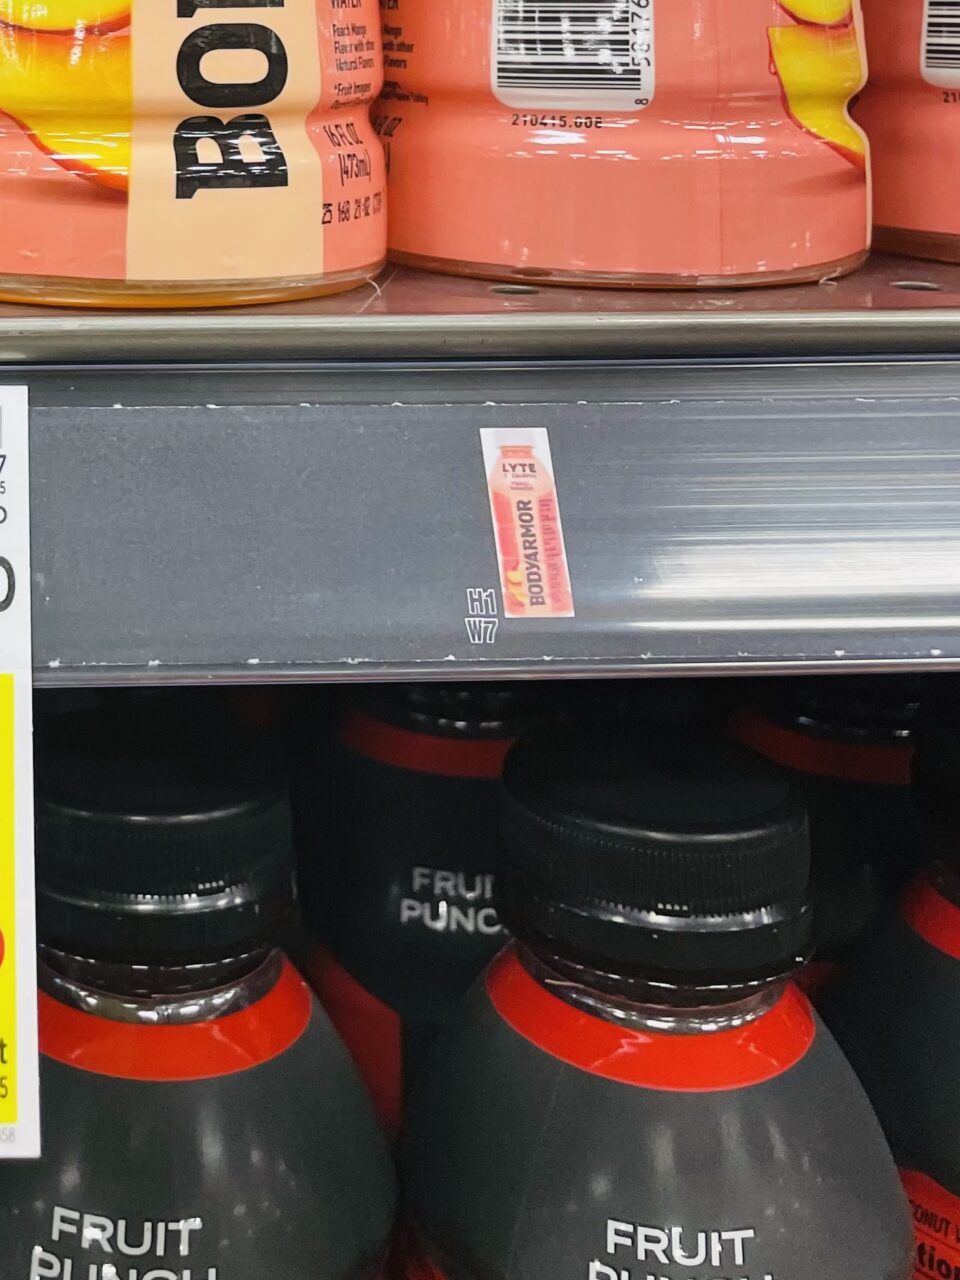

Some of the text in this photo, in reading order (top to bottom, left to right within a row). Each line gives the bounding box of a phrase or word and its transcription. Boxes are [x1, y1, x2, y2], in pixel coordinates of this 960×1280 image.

[502, 463, 537, 473] LYTE
[516, 499, 546, 606] BODYARMOR
[467, 588, 497, 615] H1
[465, 618, 499, 643] W7
[412, 866, 495, 901] FRUI
[400, 900, 506, 936] PUNC
[51, 1205, 203, 1256] FRUIT
[606, 1219, 755, 1266] FRUIT
